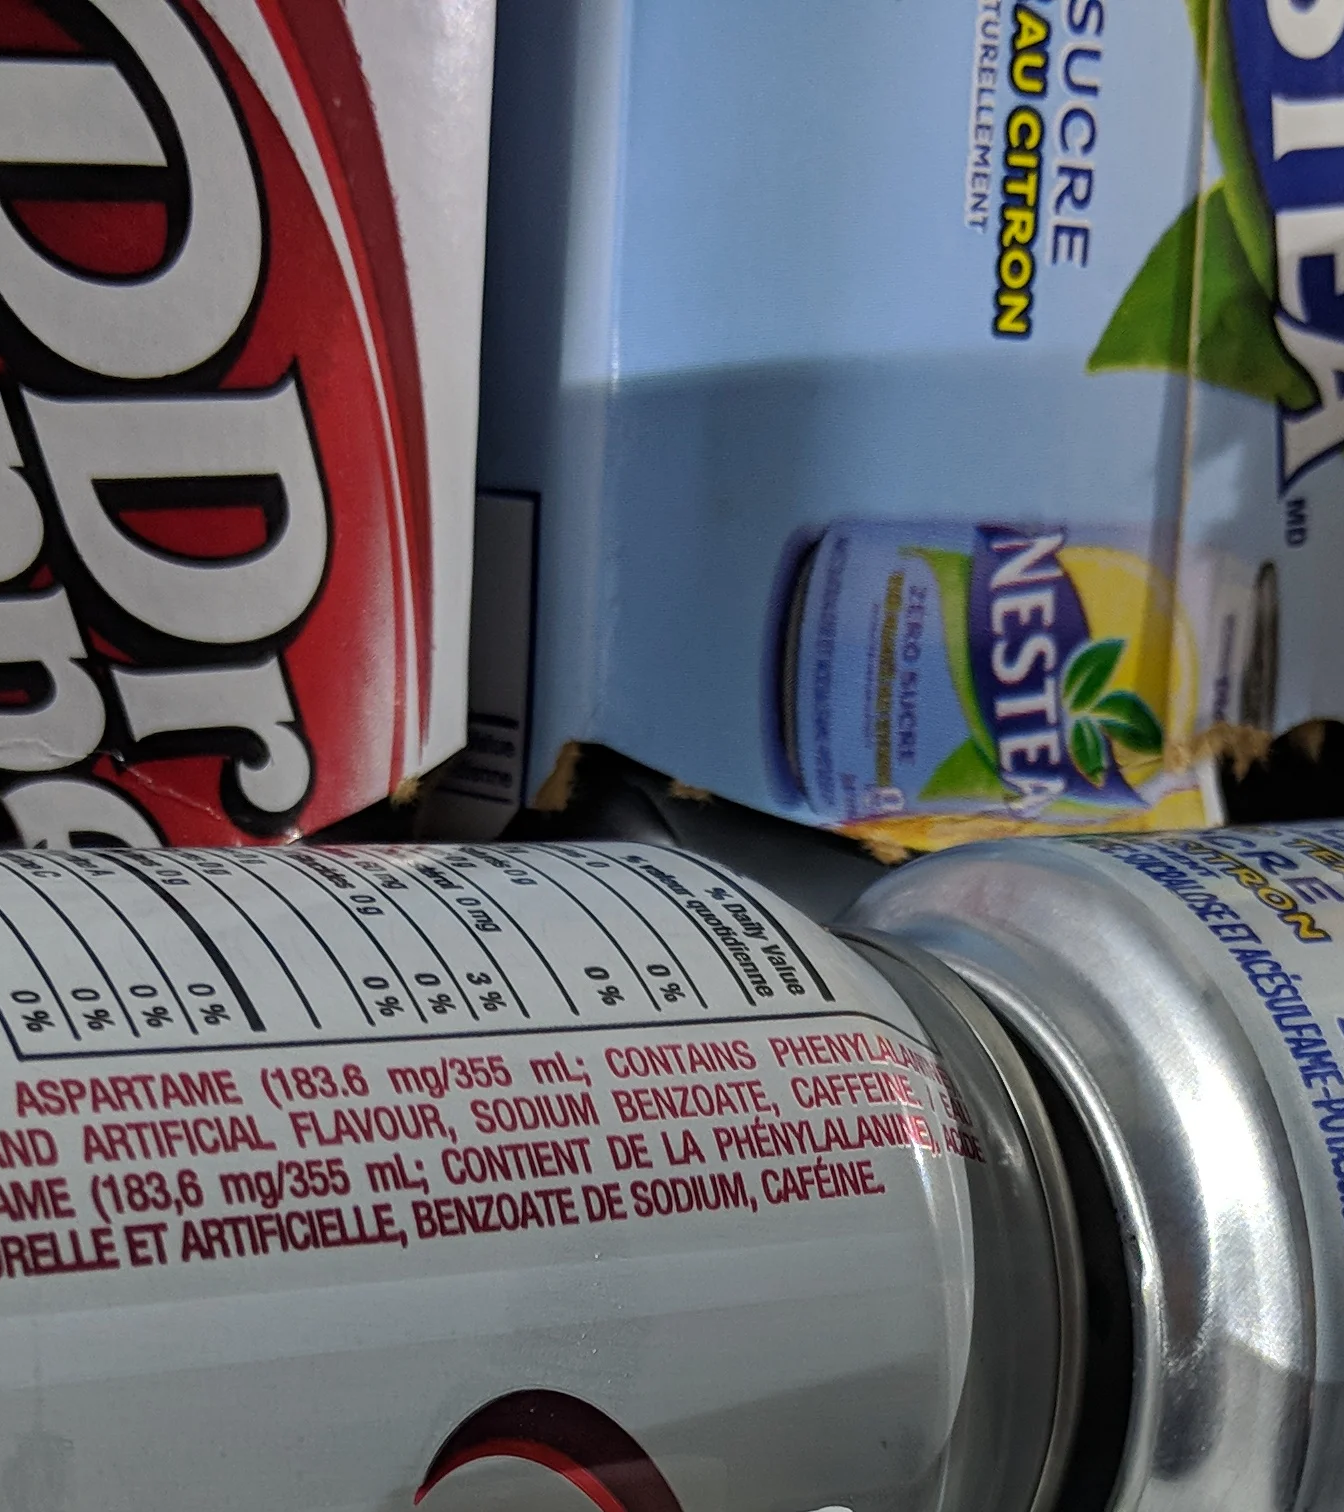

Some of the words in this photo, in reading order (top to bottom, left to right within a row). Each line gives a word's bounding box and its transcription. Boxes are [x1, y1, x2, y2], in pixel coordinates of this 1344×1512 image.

[1009, 2, 1051, 97] AU
[1051, 0, 1105, 268] SUCRE
[993, 104, 1046, 340] CITRON
[721, 902, 770, 943] Daily
[761, 943, 807, 998] Value
[14, 1068, 244, 1118] ASPARTAME
[259, 1062, 371, 1110] (183.6
[386, 1054, 514, 1099] mg/355
[528, 1049, 594, 1087] mL;
[603, 1037, 758, 1080] CONTAINS
[81, 1113, 277, 1166] ARTIFICIAL
[287, 1103, 459, 1149] FLAVOUR,
[469, 1090, 602, 1135] SODIUM
[611, 1078, 782, 1125] BENZOATE,
[90, 1167, 205, 1224] (183,6
[219, 1156, 353, 1209] mg/355
[364, 1151, 431, 1195] mL;
[440, 1136, 594, 1187] CONTIENT
[605, 1132, 654, 1173] DE
[660, 1127, 707, 1166] LA
[123, 1221, 170, 1269] ET
[179, 1202, 410, 1265] ARTIFICIELLE,
[410, 1187, 581, 1241] BENZOATE
[582, 1182, 629, 1225] DE
[630, 1170, 758, 1219] SODIUM,
[759, 1153, 887, 1206] CAFÉINE.
